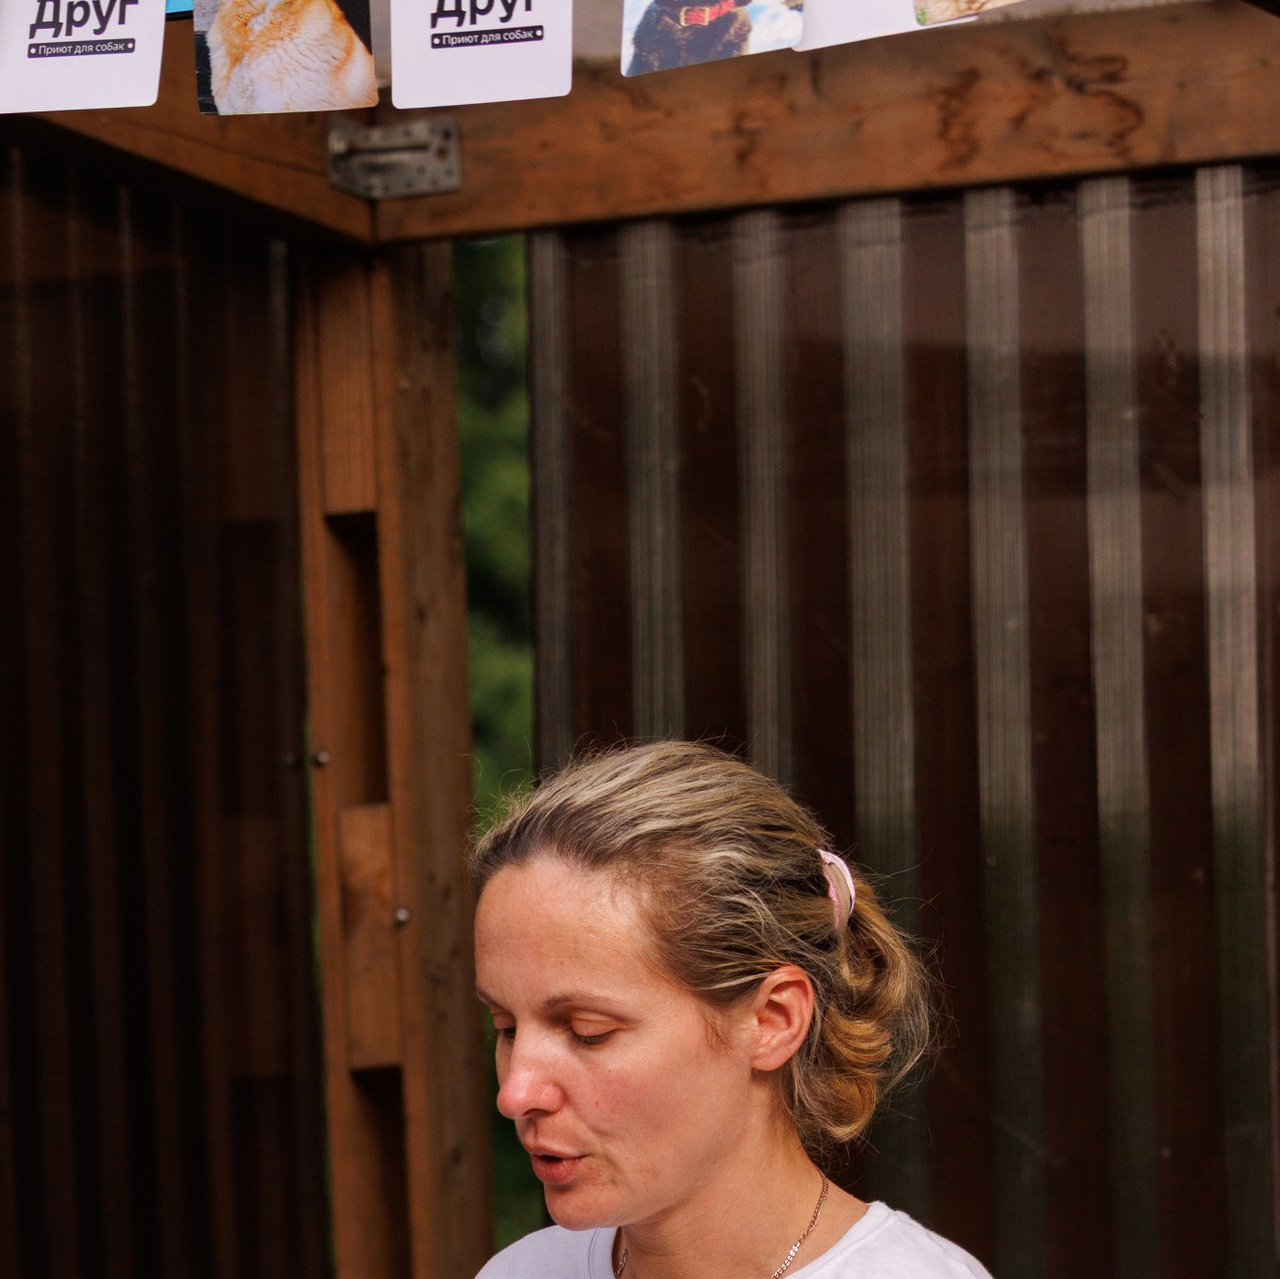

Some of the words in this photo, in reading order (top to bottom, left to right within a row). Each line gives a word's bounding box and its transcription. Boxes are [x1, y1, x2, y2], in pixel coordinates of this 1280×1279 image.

[28, 0, 139, 39] Друг
[442, 34, 479, 46] Приют
[480, 33, 501, 44] для
[502, 29, 534, 41] собак
[38, 45, 73, 56] Приют
[74, 43, 94, 54] для
[95, 41, 125, 52] собак
